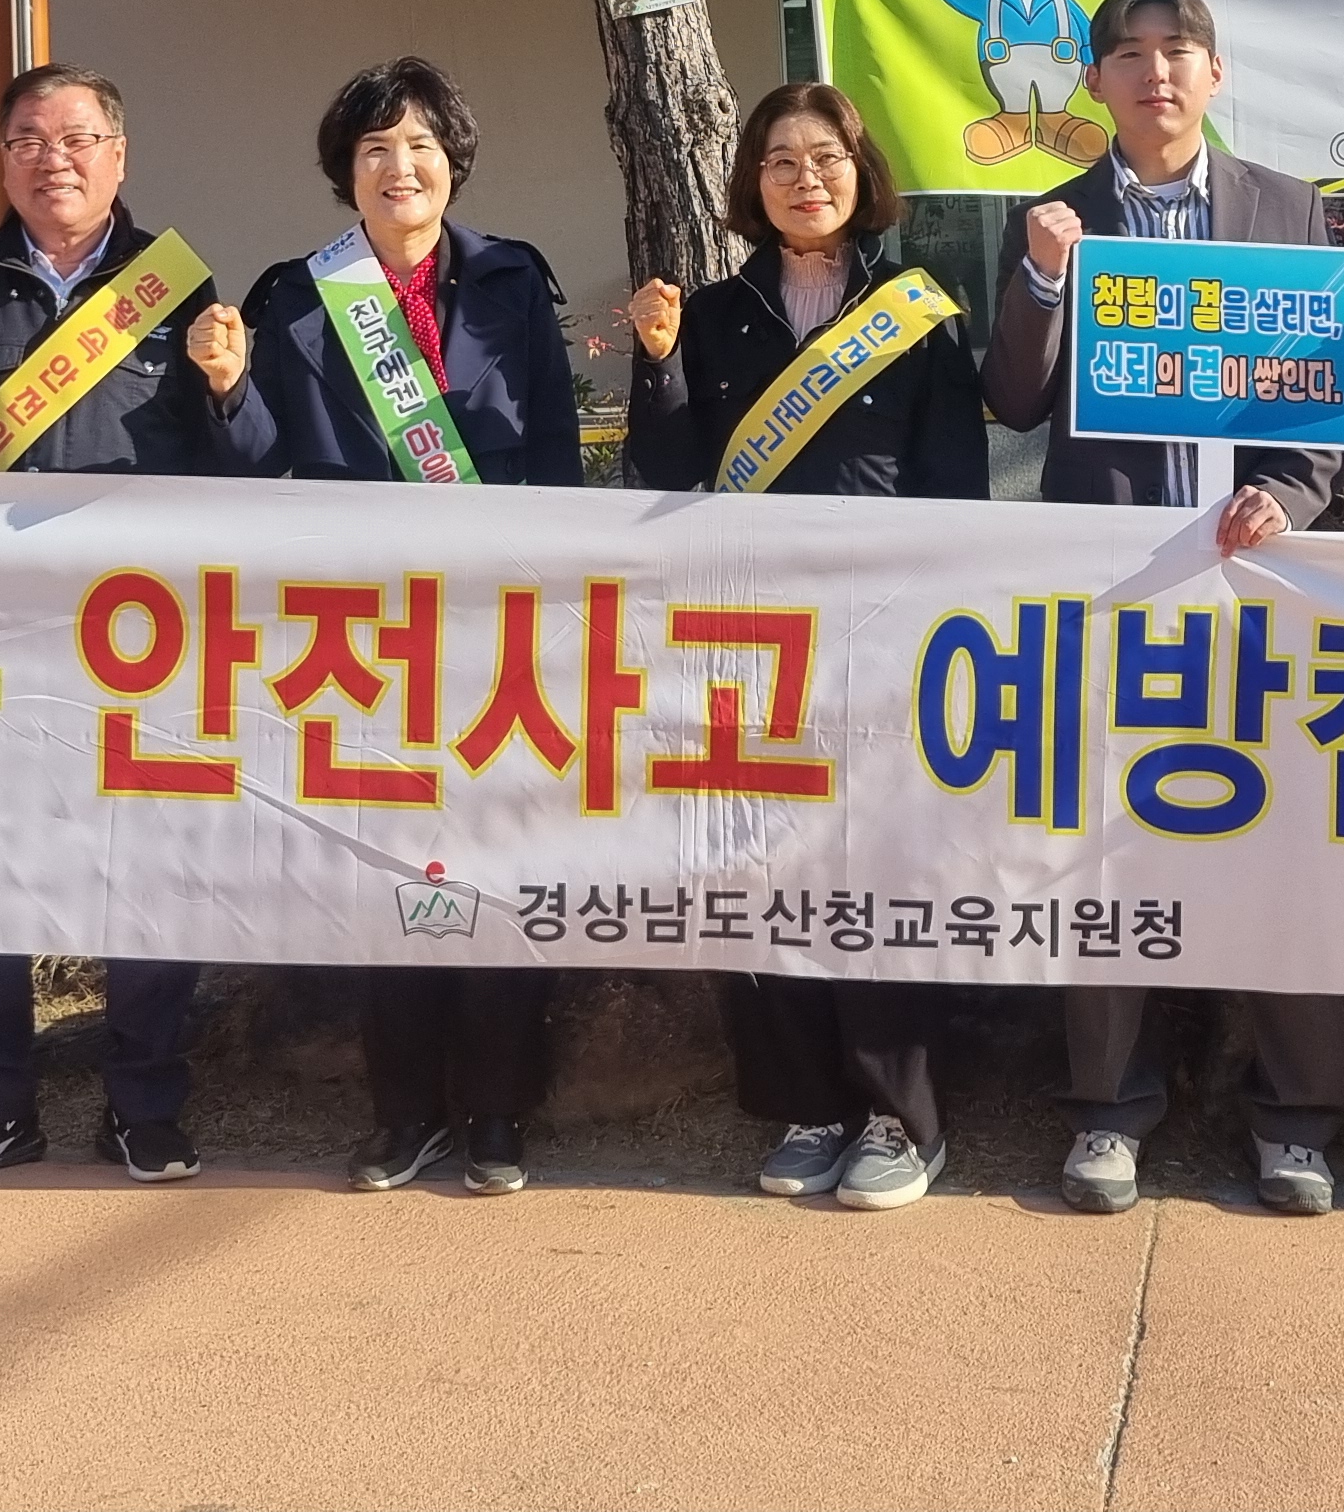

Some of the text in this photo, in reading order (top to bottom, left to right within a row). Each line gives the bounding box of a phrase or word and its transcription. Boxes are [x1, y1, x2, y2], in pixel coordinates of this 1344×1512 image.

[1092, 273, 1343, 340] 청렴의 결을 살리면,
[349, 298, 426, 414] 친구에겐
[1091, 341, 1343, 405] 신뢰의 결이 쌓인다.
[74, 565, 835, 817] 안전사고
[516, 881, 1183, 959] 경상남도산청교육지원청
